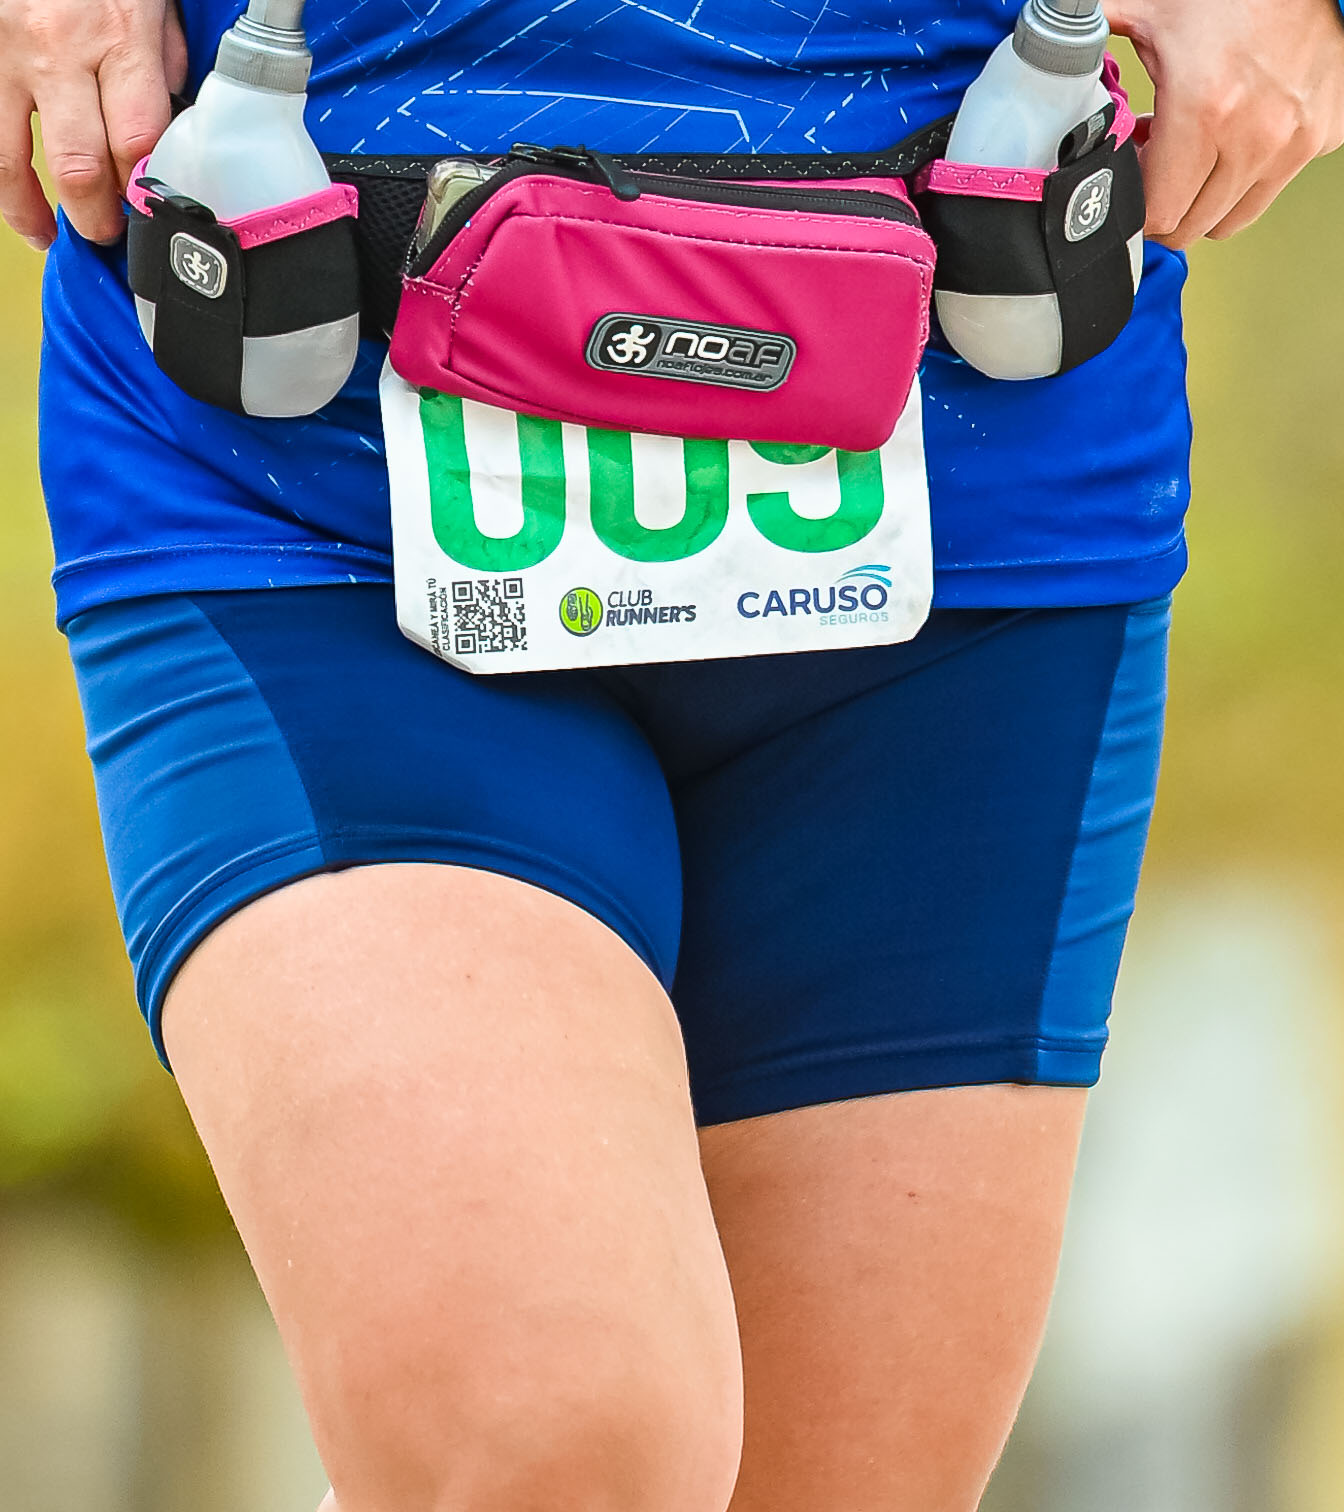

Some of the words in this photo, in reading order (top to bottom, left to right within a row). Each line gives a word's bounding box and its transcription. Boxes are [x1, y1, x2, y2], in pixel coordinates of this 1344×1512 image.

[607, 589, 653, 608] CLUB
[737, 583, 888, 619] CARUSO
[605, 604, 697, 627] RUNNER'S
[819, 611, 889, 626] SEGUROS
